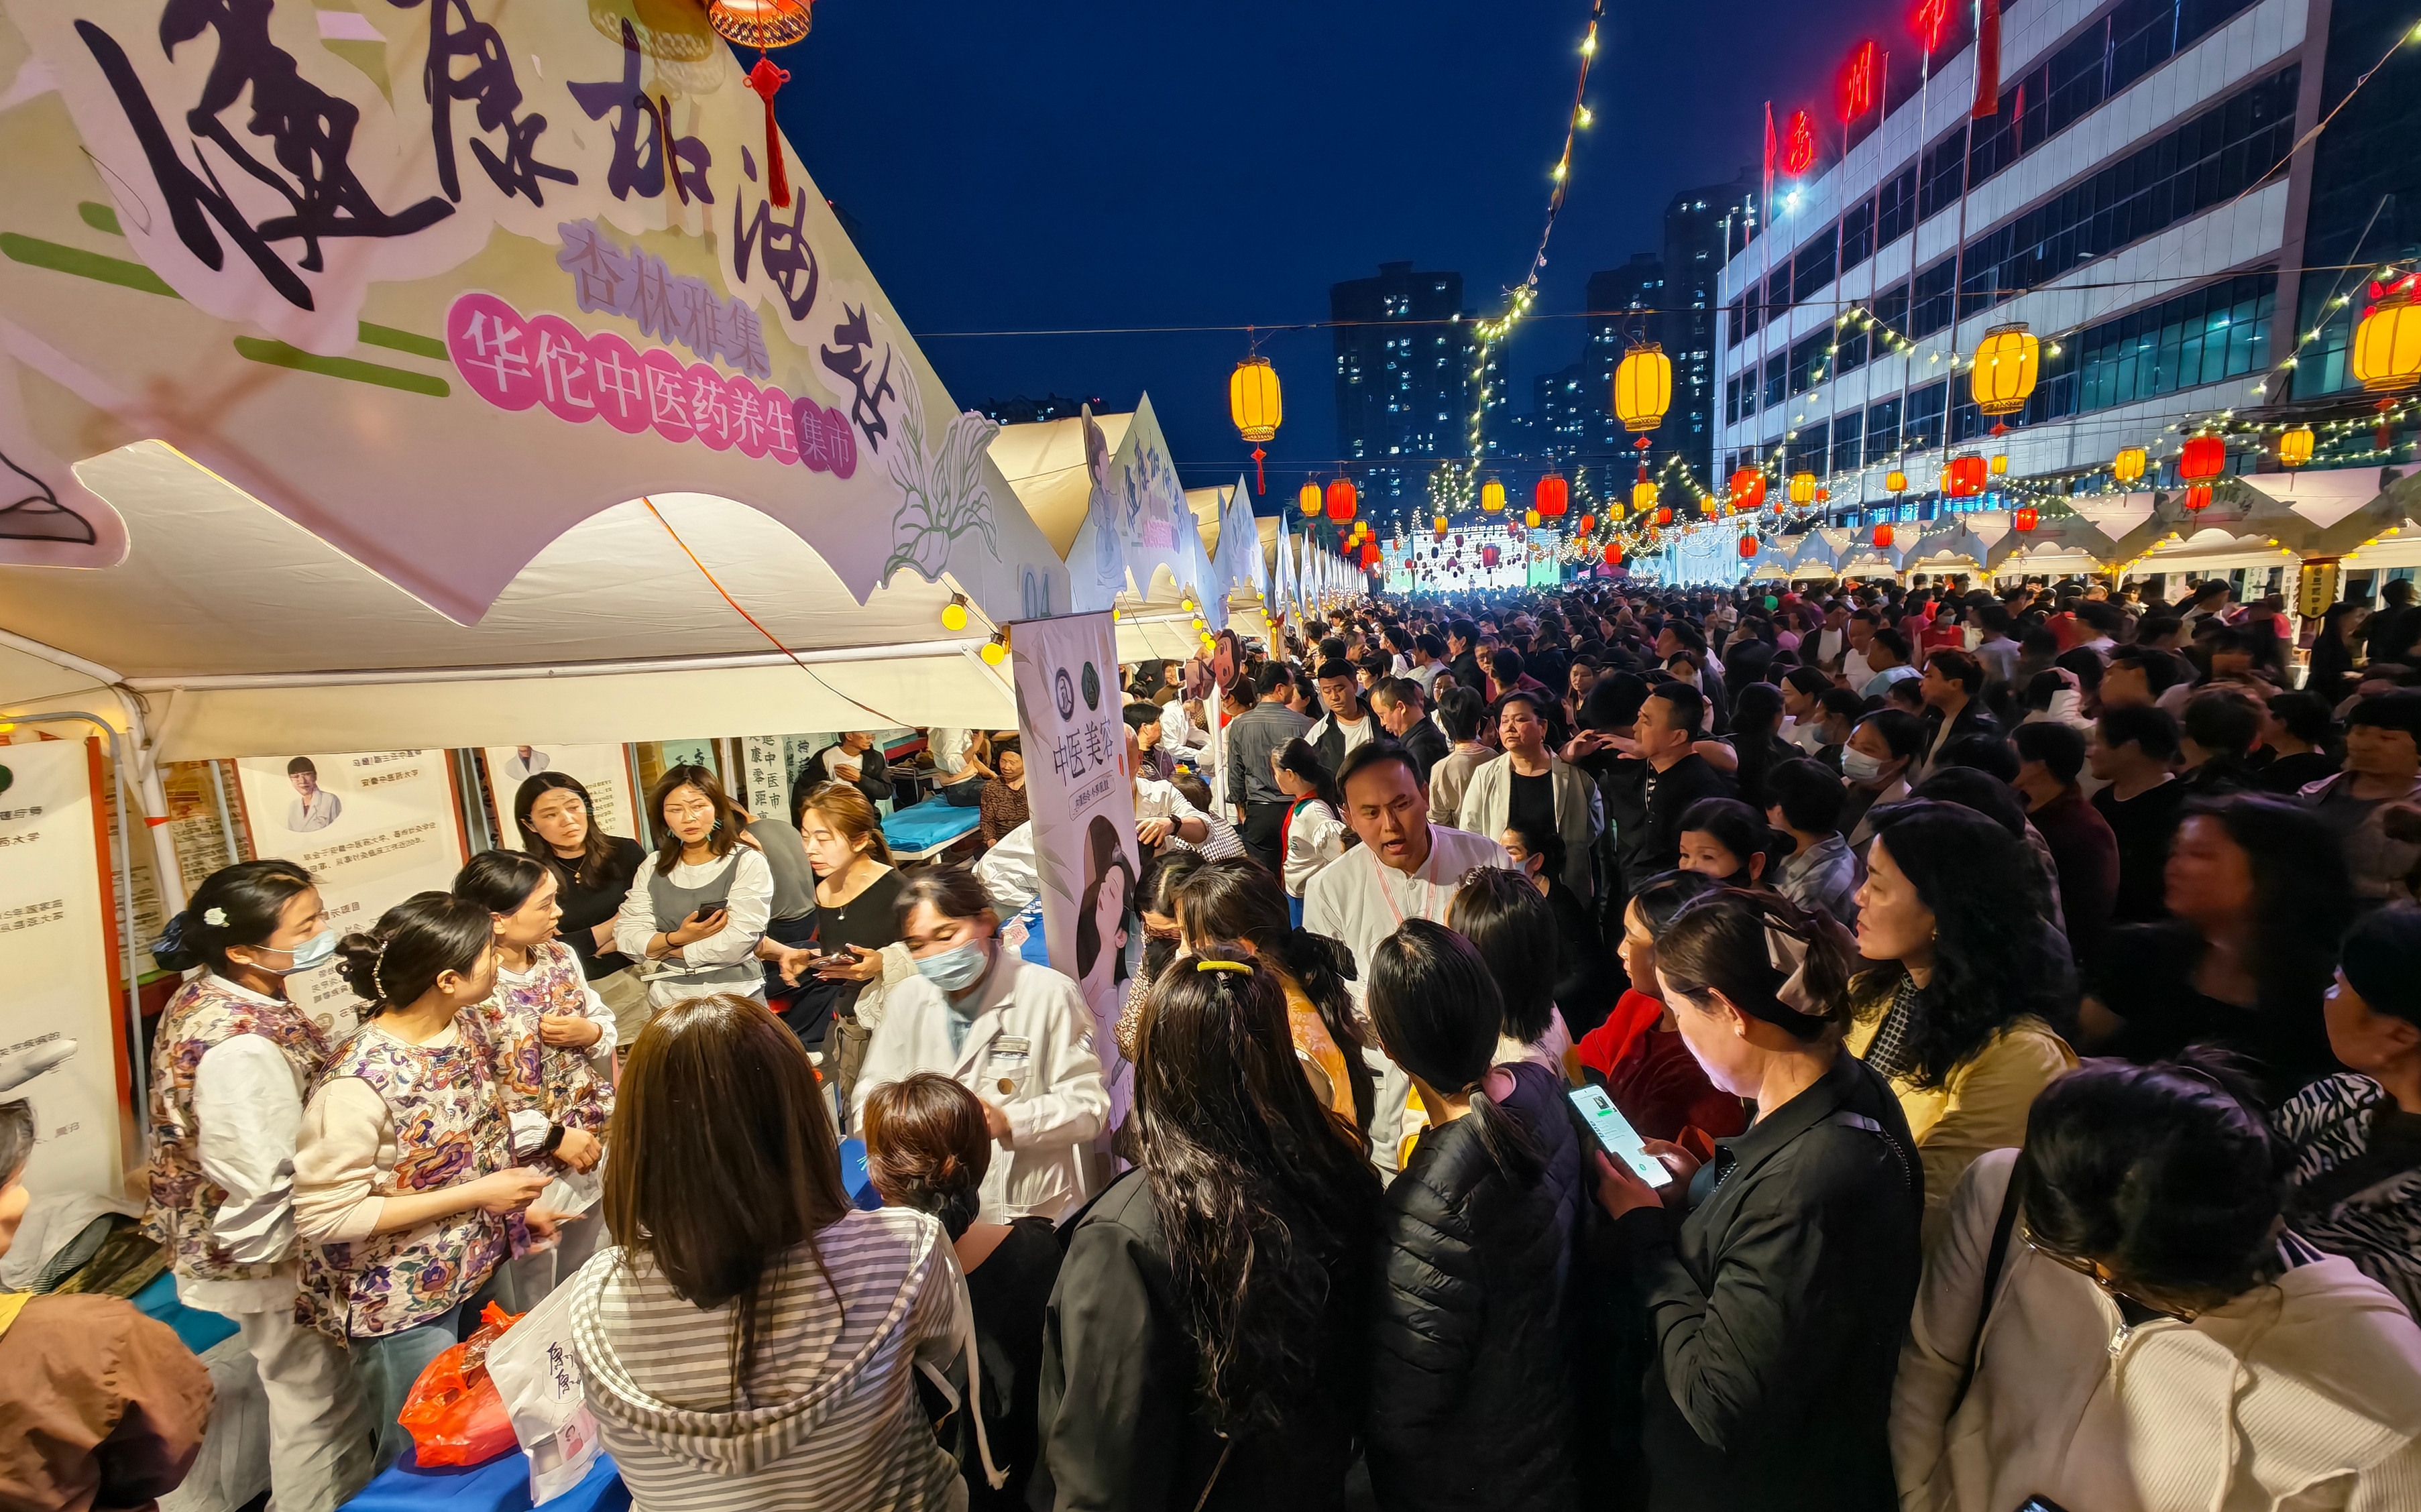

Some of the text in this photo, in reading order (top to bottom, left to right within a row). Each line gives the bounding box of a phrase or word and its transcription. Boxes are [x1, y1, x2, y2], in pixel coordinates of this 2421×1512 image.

[569, 229, 769, 373] 杏林雅集
[463, 310, 851, 470] 华佗中医药养生集市
[1053, 715, 1113, 787] 中医美容
